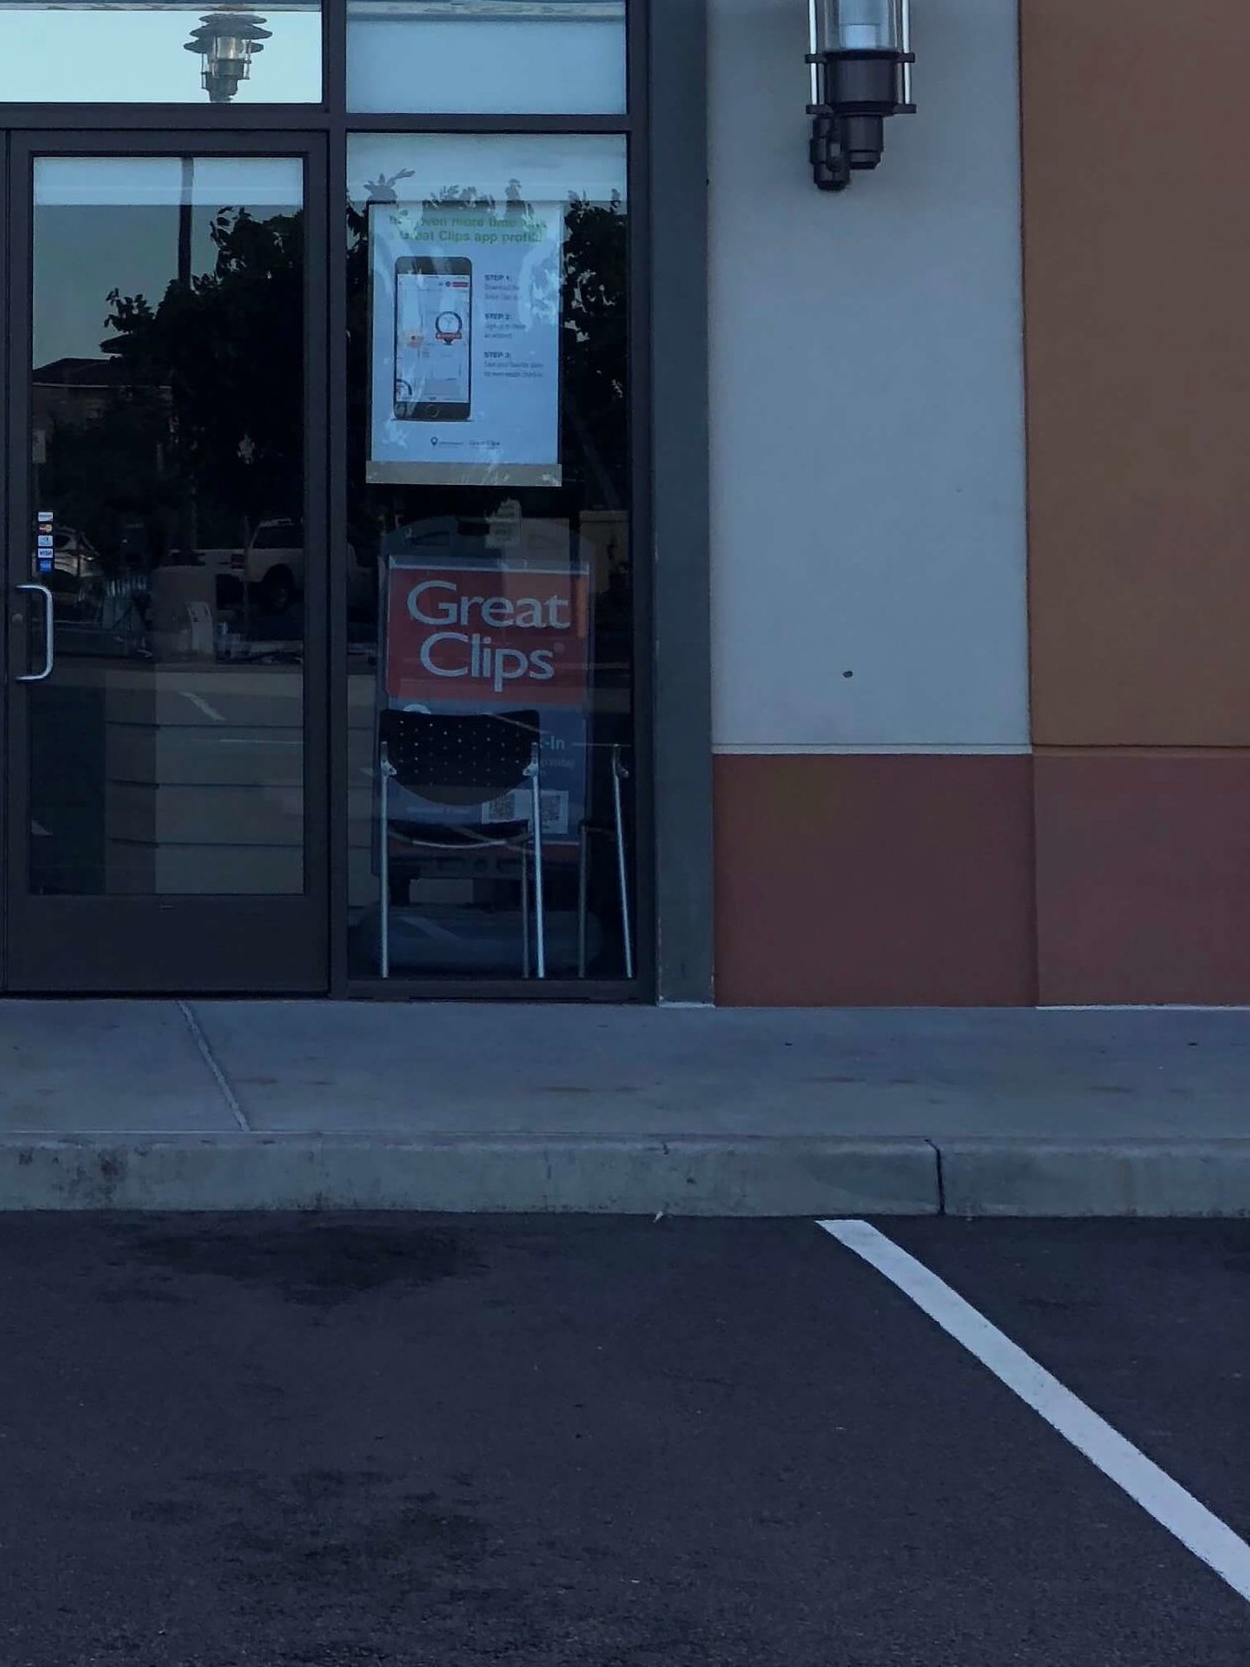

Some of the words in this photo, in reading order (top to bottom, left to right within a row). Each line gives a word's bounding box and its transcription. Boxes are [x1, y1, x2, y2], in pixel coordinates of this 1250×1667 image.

[438, 229, 470, 242] Clips
[474, 233, 498, 244] app
[407, 580, 571, 630] Great
[419, 631, 556, 693] Clips
